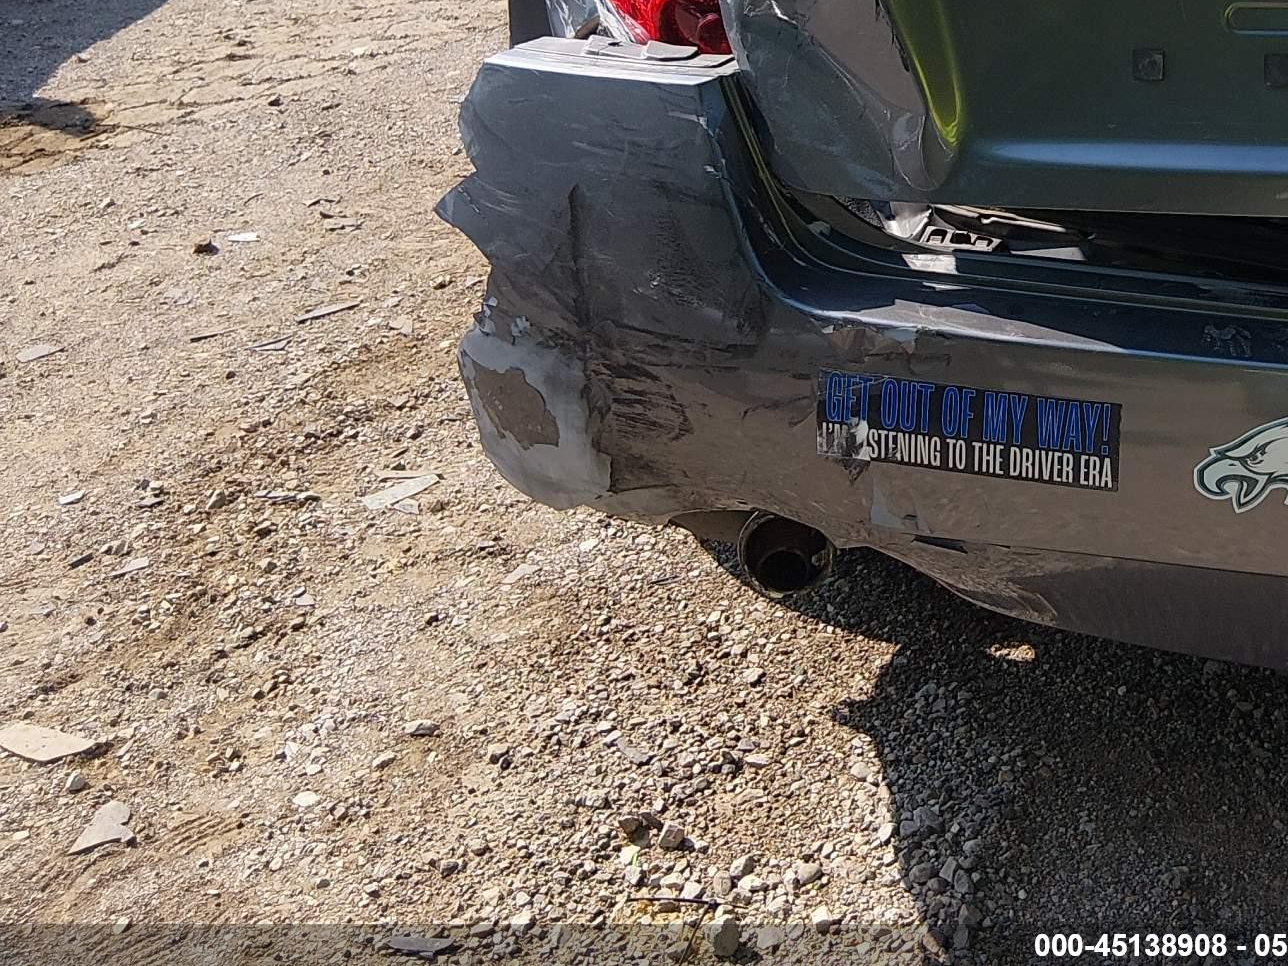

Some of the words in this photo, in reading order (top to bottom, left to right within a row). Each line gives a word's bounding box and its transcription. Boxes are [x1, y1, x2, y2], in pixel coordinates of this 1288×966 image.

[825, 371, 874, 423] GET
[880, 377, 935, 433] OUT
[941, 386, 976, 439] OF
[982, 390, 1028, 445] MY
[1036, 396, 1112, 455] WAY!
[946, 438, 966, 470] TO
[972, 441, 1005, 475] THE
[1009, 446, 1074, 484] DRIVER
[1079, 455, 1114, 489] ERA
